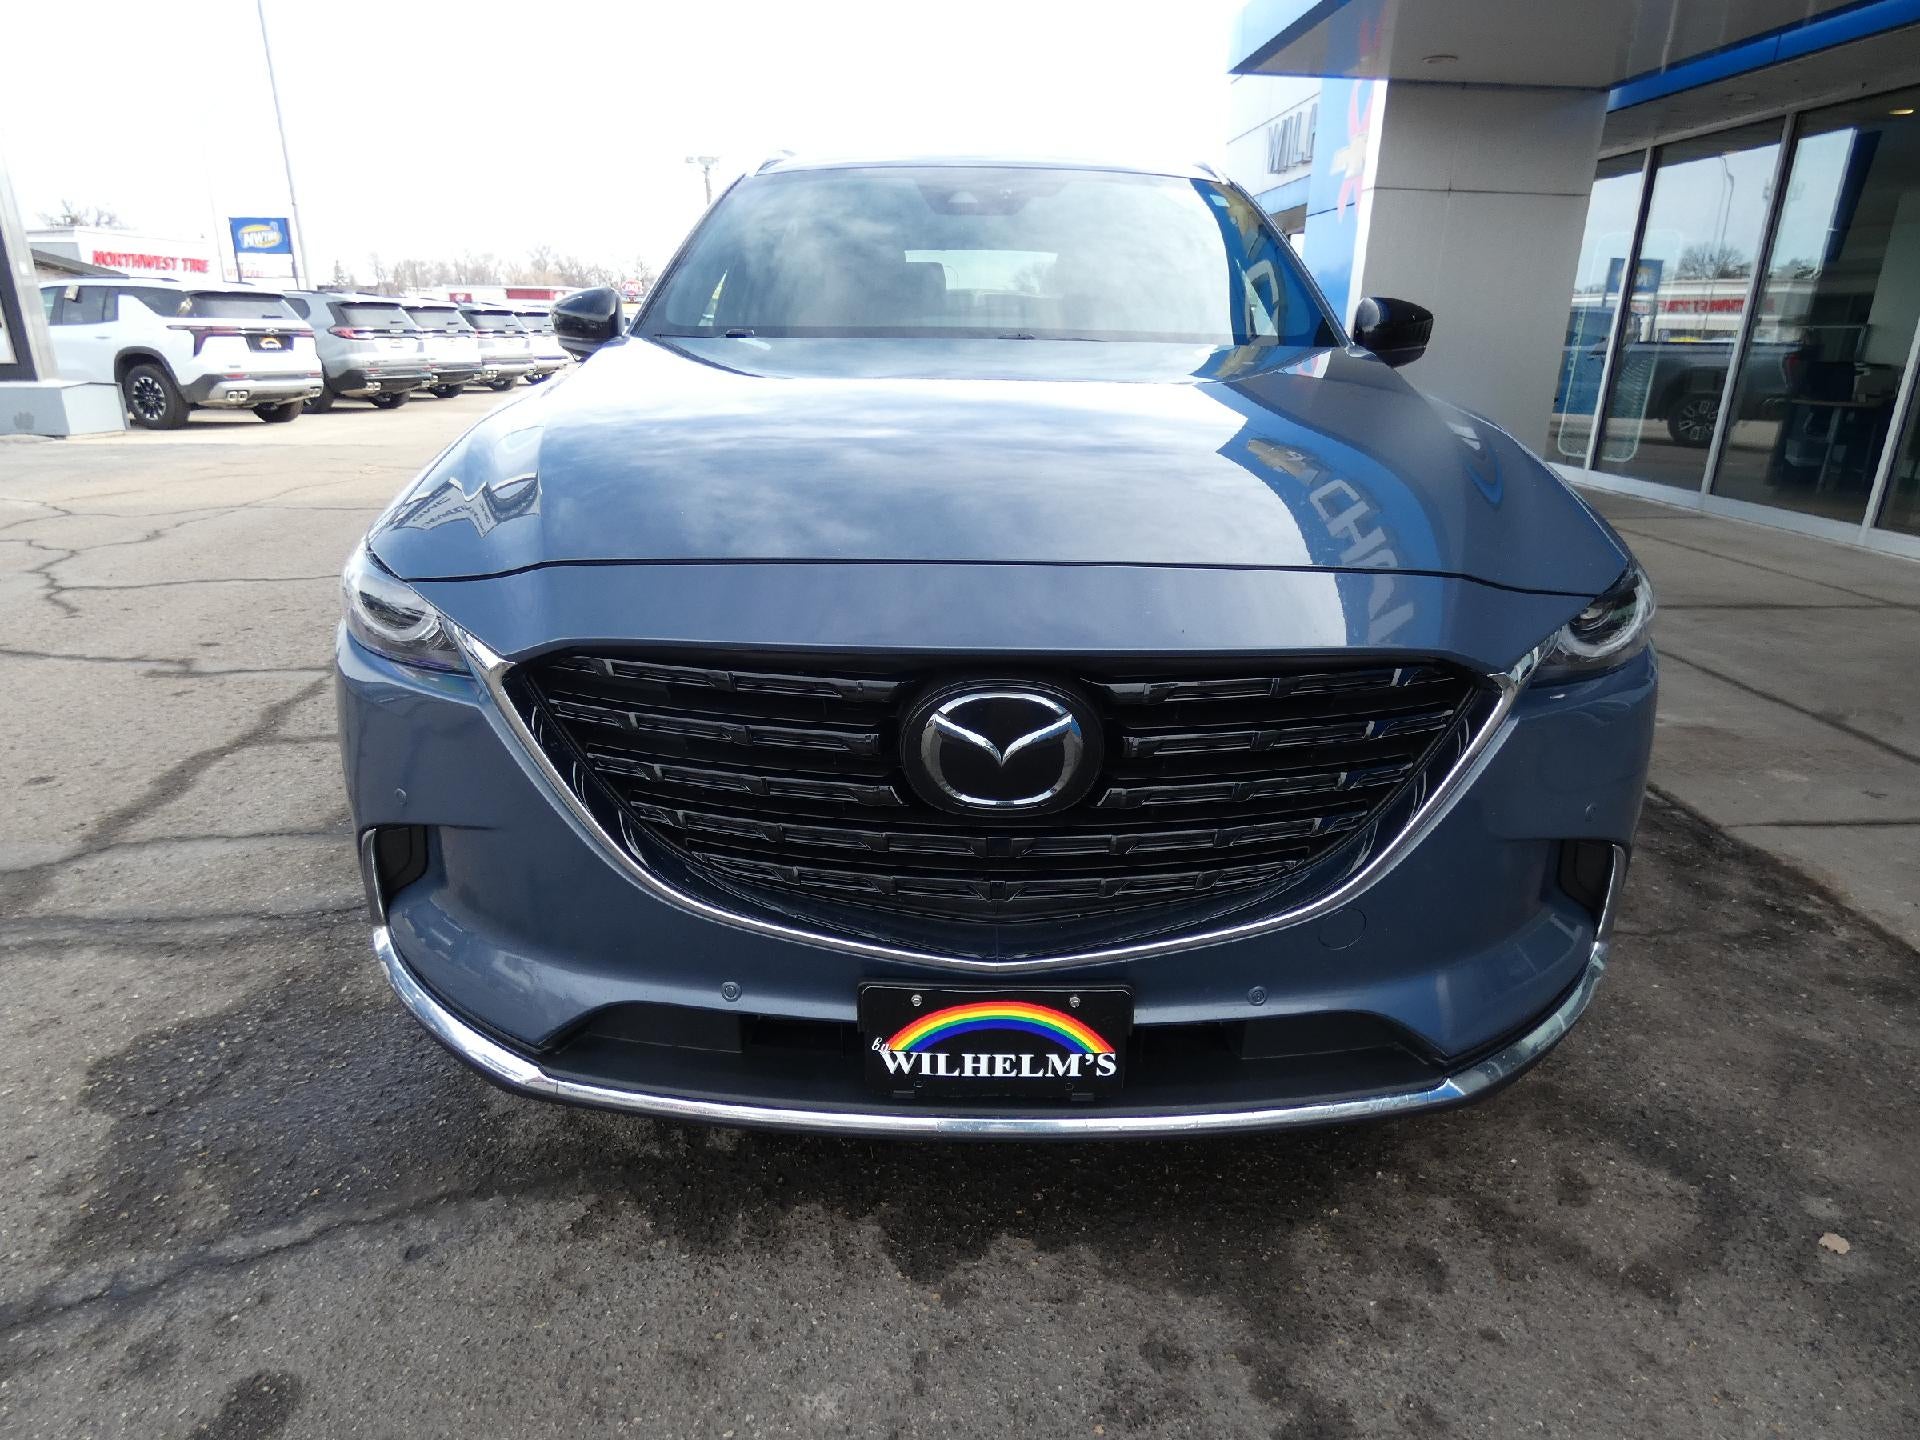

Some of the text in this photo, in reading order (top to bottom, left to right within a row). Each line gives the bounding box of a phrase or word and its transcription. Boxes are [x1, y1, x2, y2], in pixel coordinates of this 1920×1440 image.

[92, 250, 178, 271] NORTHWEST
[181, 257, 209, 273] TIRE
[878, 1050, 1117, 1078] WILHELM'S
